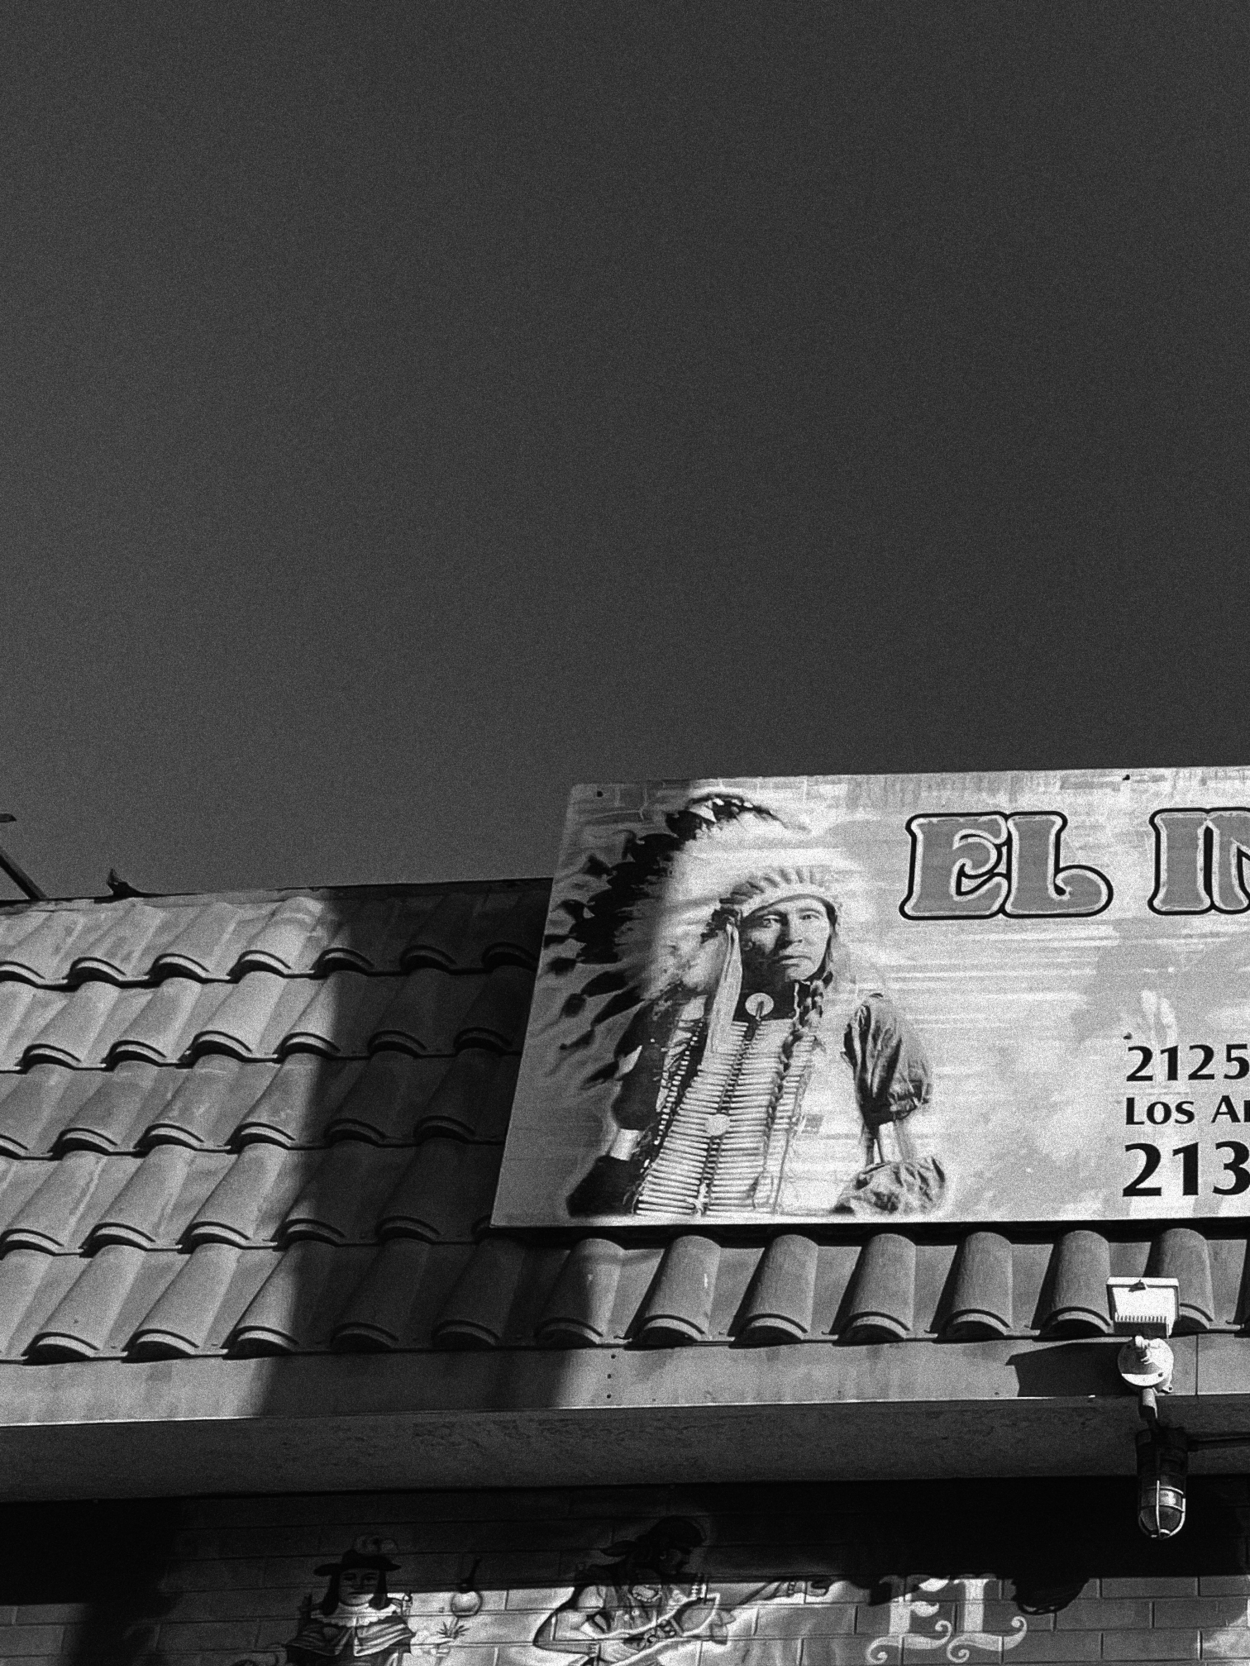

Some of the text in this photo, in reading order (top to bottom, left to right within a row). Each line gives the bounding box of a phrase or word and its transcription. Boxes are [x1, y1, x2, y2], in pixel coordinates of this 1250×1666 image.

[900, 811, 1114, 920] EL
[1125, 1043, 1250, 1083] 2125
[1124, 1095, 1195, 1127] Los
[866, 1574, 1027, 1664] EL
